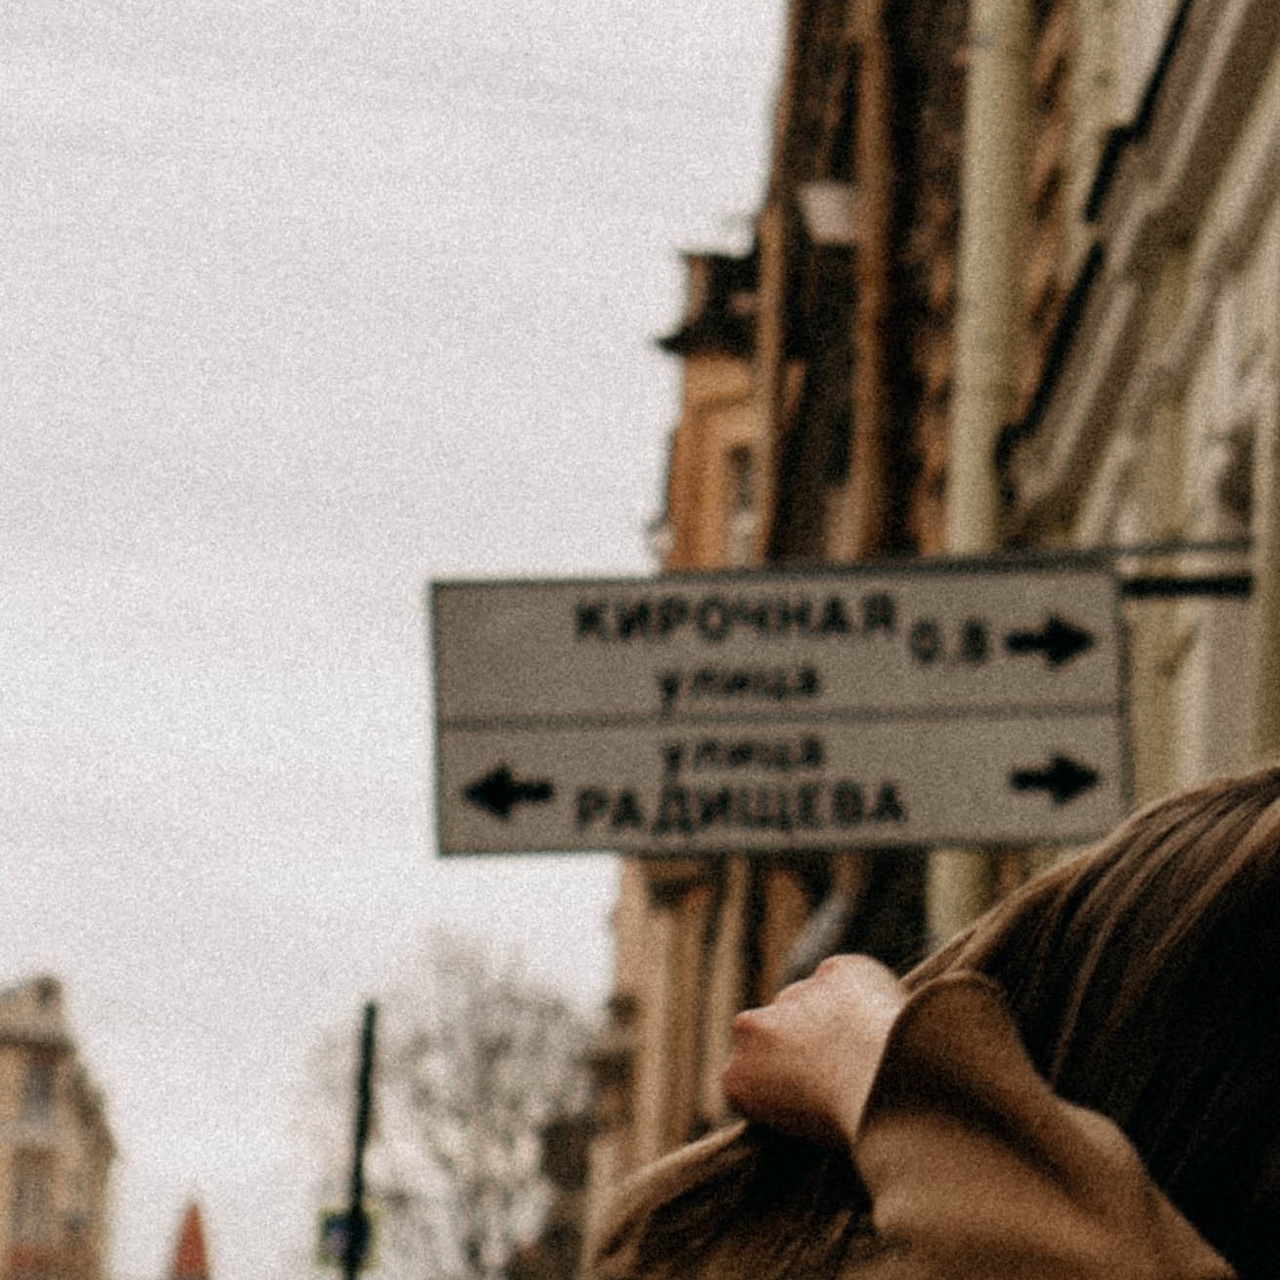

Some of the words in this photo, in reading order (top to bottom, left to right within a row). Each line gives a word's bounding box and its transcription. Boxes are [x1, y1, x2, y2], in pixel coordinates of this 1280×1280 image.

[575, 590, 897, 644] КИРОЧНАЯ
[658, 664, 821, 714] улица
[661, 734, 826, 783] улица
[574, 781, 906, 836] РАДИЩЕВА
